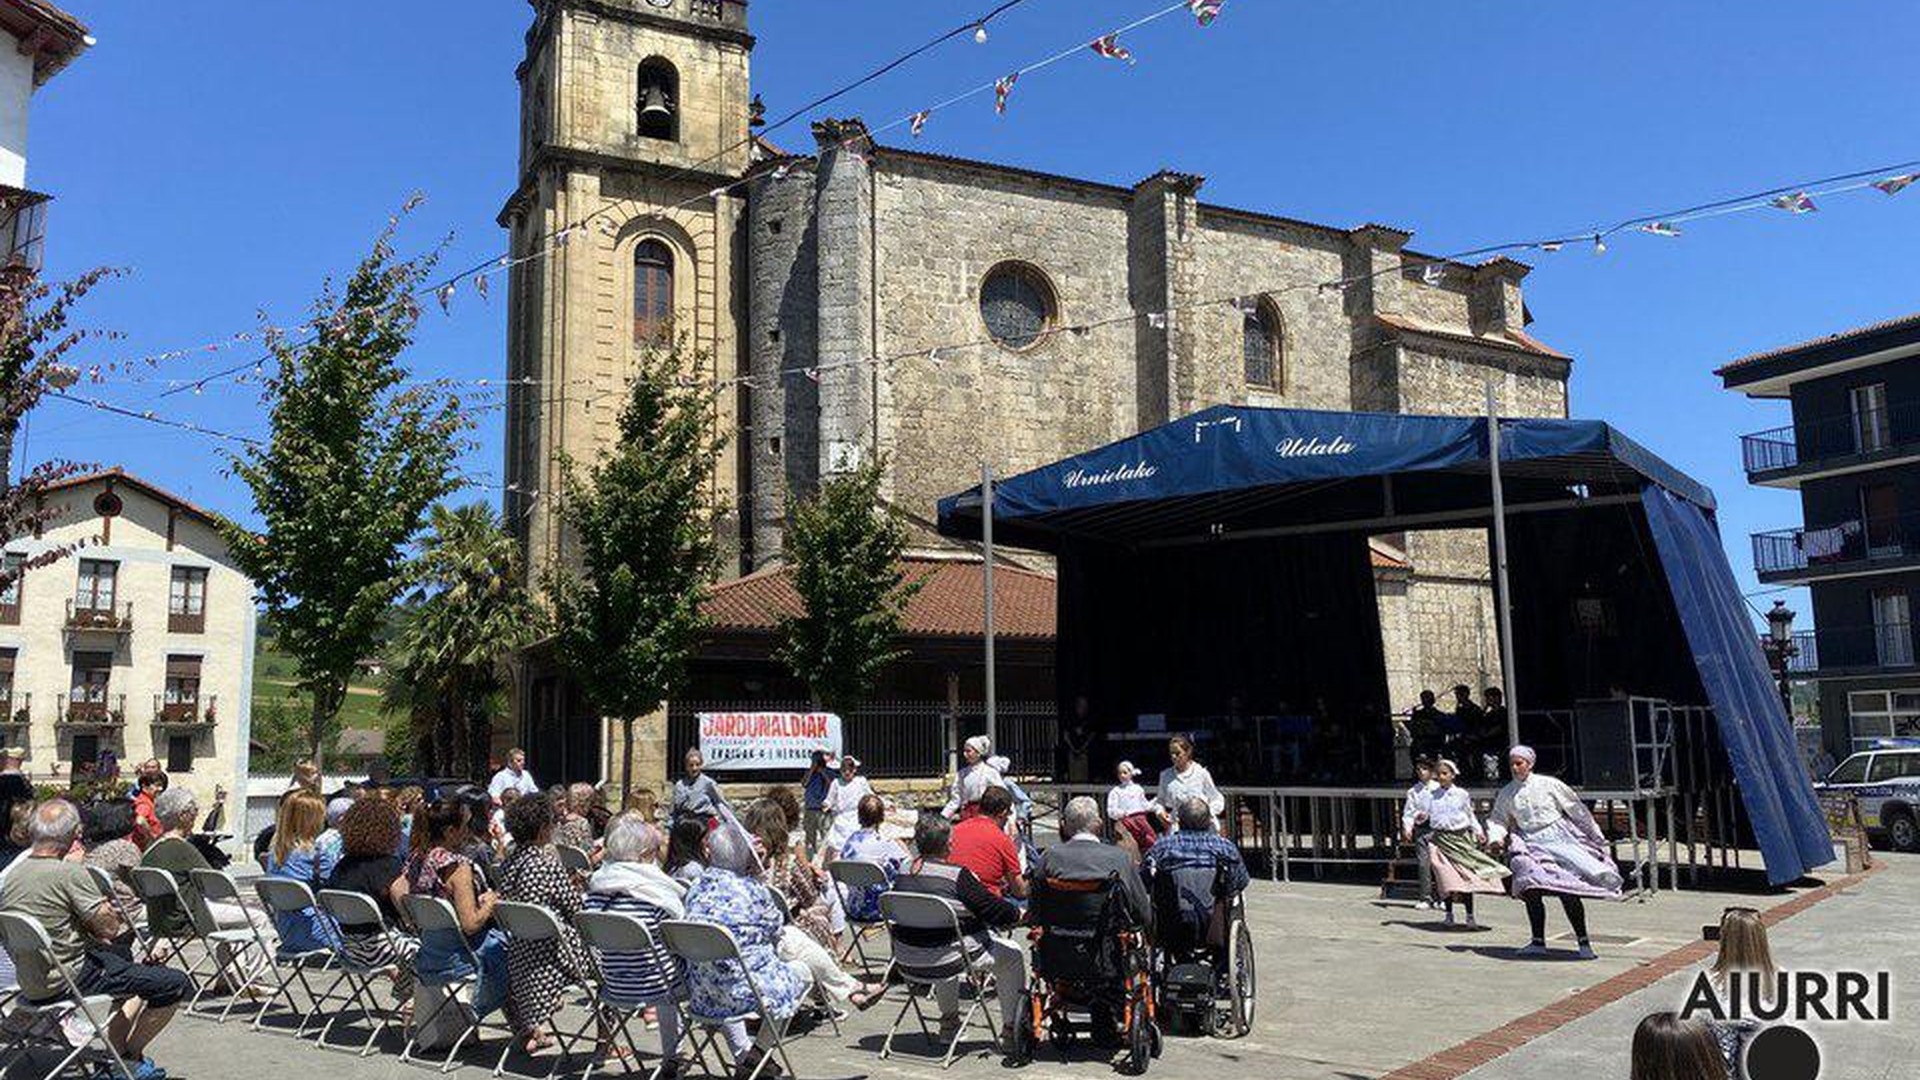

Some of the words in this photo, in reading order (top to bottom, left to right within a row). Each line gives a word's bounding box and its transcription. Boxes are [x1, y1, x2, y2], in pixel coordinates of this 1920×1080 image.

[1063, 460, 1157, 488] Urnietako
[1275, 436, 1355, 458] Udala
[704, 714, 827, 737] JARDUNALDIAK
